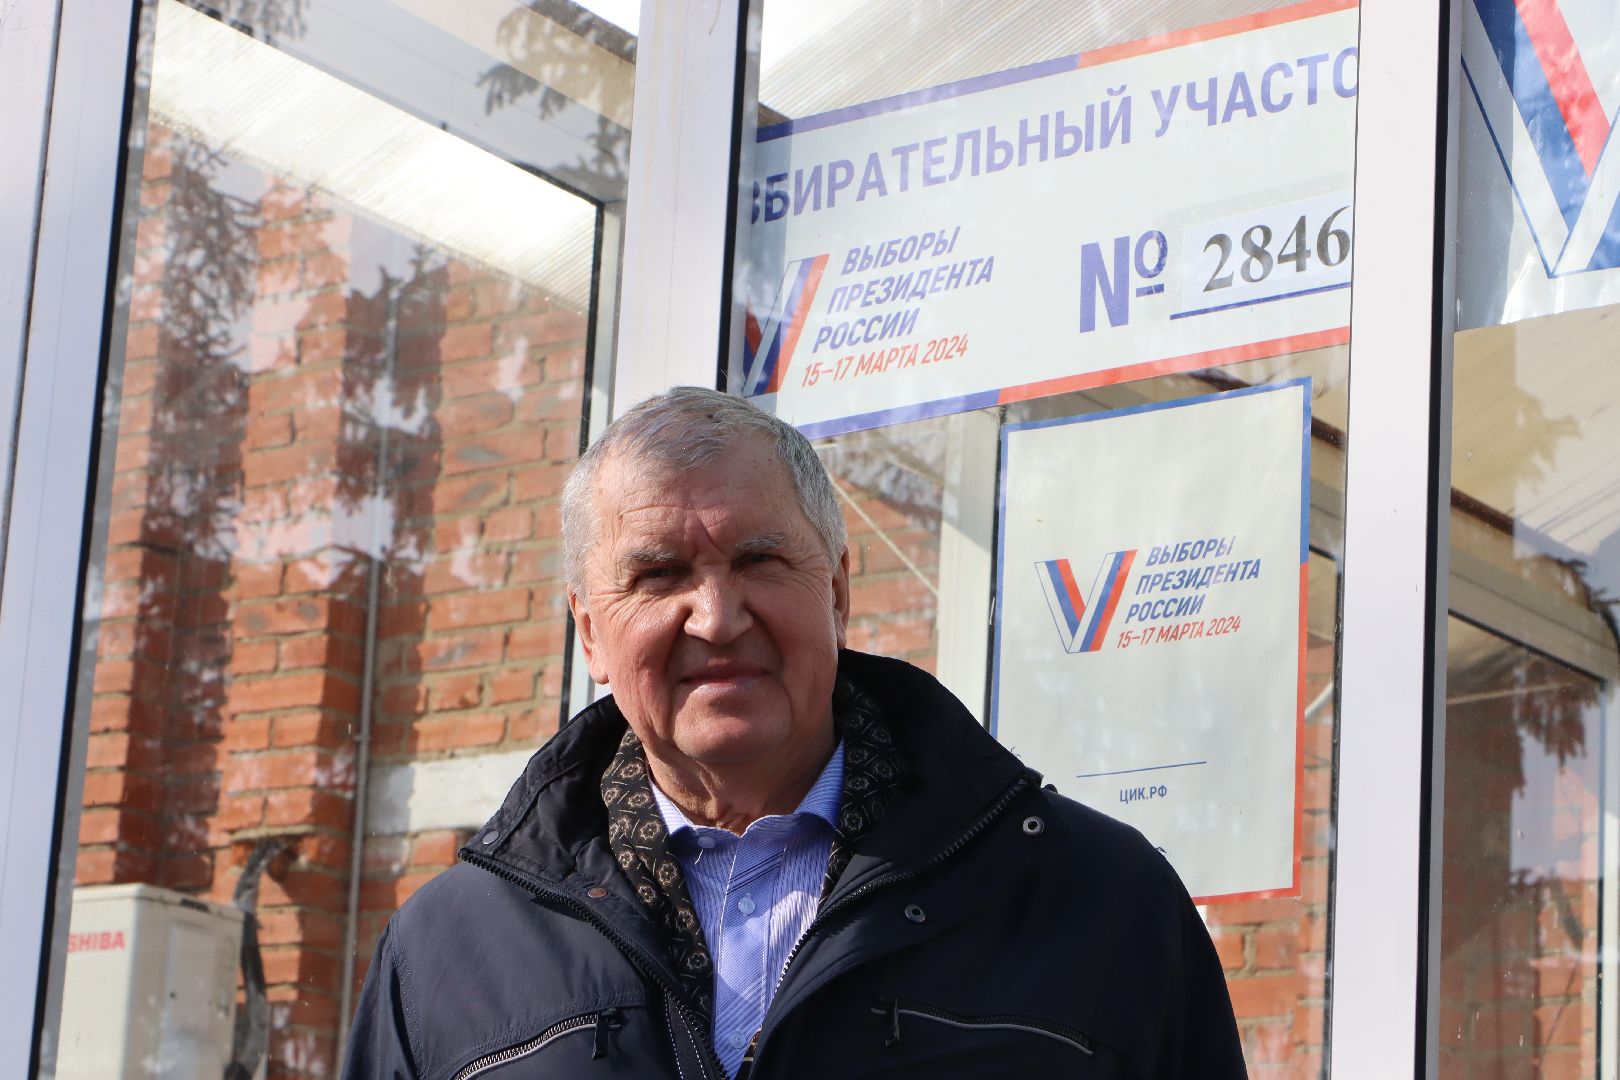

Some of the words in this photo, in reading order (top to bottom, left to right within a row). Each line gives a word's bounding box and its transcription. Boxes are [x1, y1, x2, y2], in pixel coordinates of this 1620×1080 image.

[841, 226, 961, 276] ВЫБОРЫ
[1203, 205, 1351, 293] 2846
[827, 255, 995, 315] ПРЕЗИДЕНТА
[812, 307, 920, 354] РОССИИ
[854, 343, 919, 377] МАРТА
[920, 334, 968, 364] 2024
[1145, 535, 1237, 567] ВЫБОРЫ
[1135, 558, 1262, 596] ПРЕЗИДЕНТА
[1125, 593, 1207, 624] РОССИИ
[1155, 620, 1205, 643] МАРТА
[1205, 615, 1242, 637] 2024
[1119, 784, 1168, 804] ЦИК.РФ
